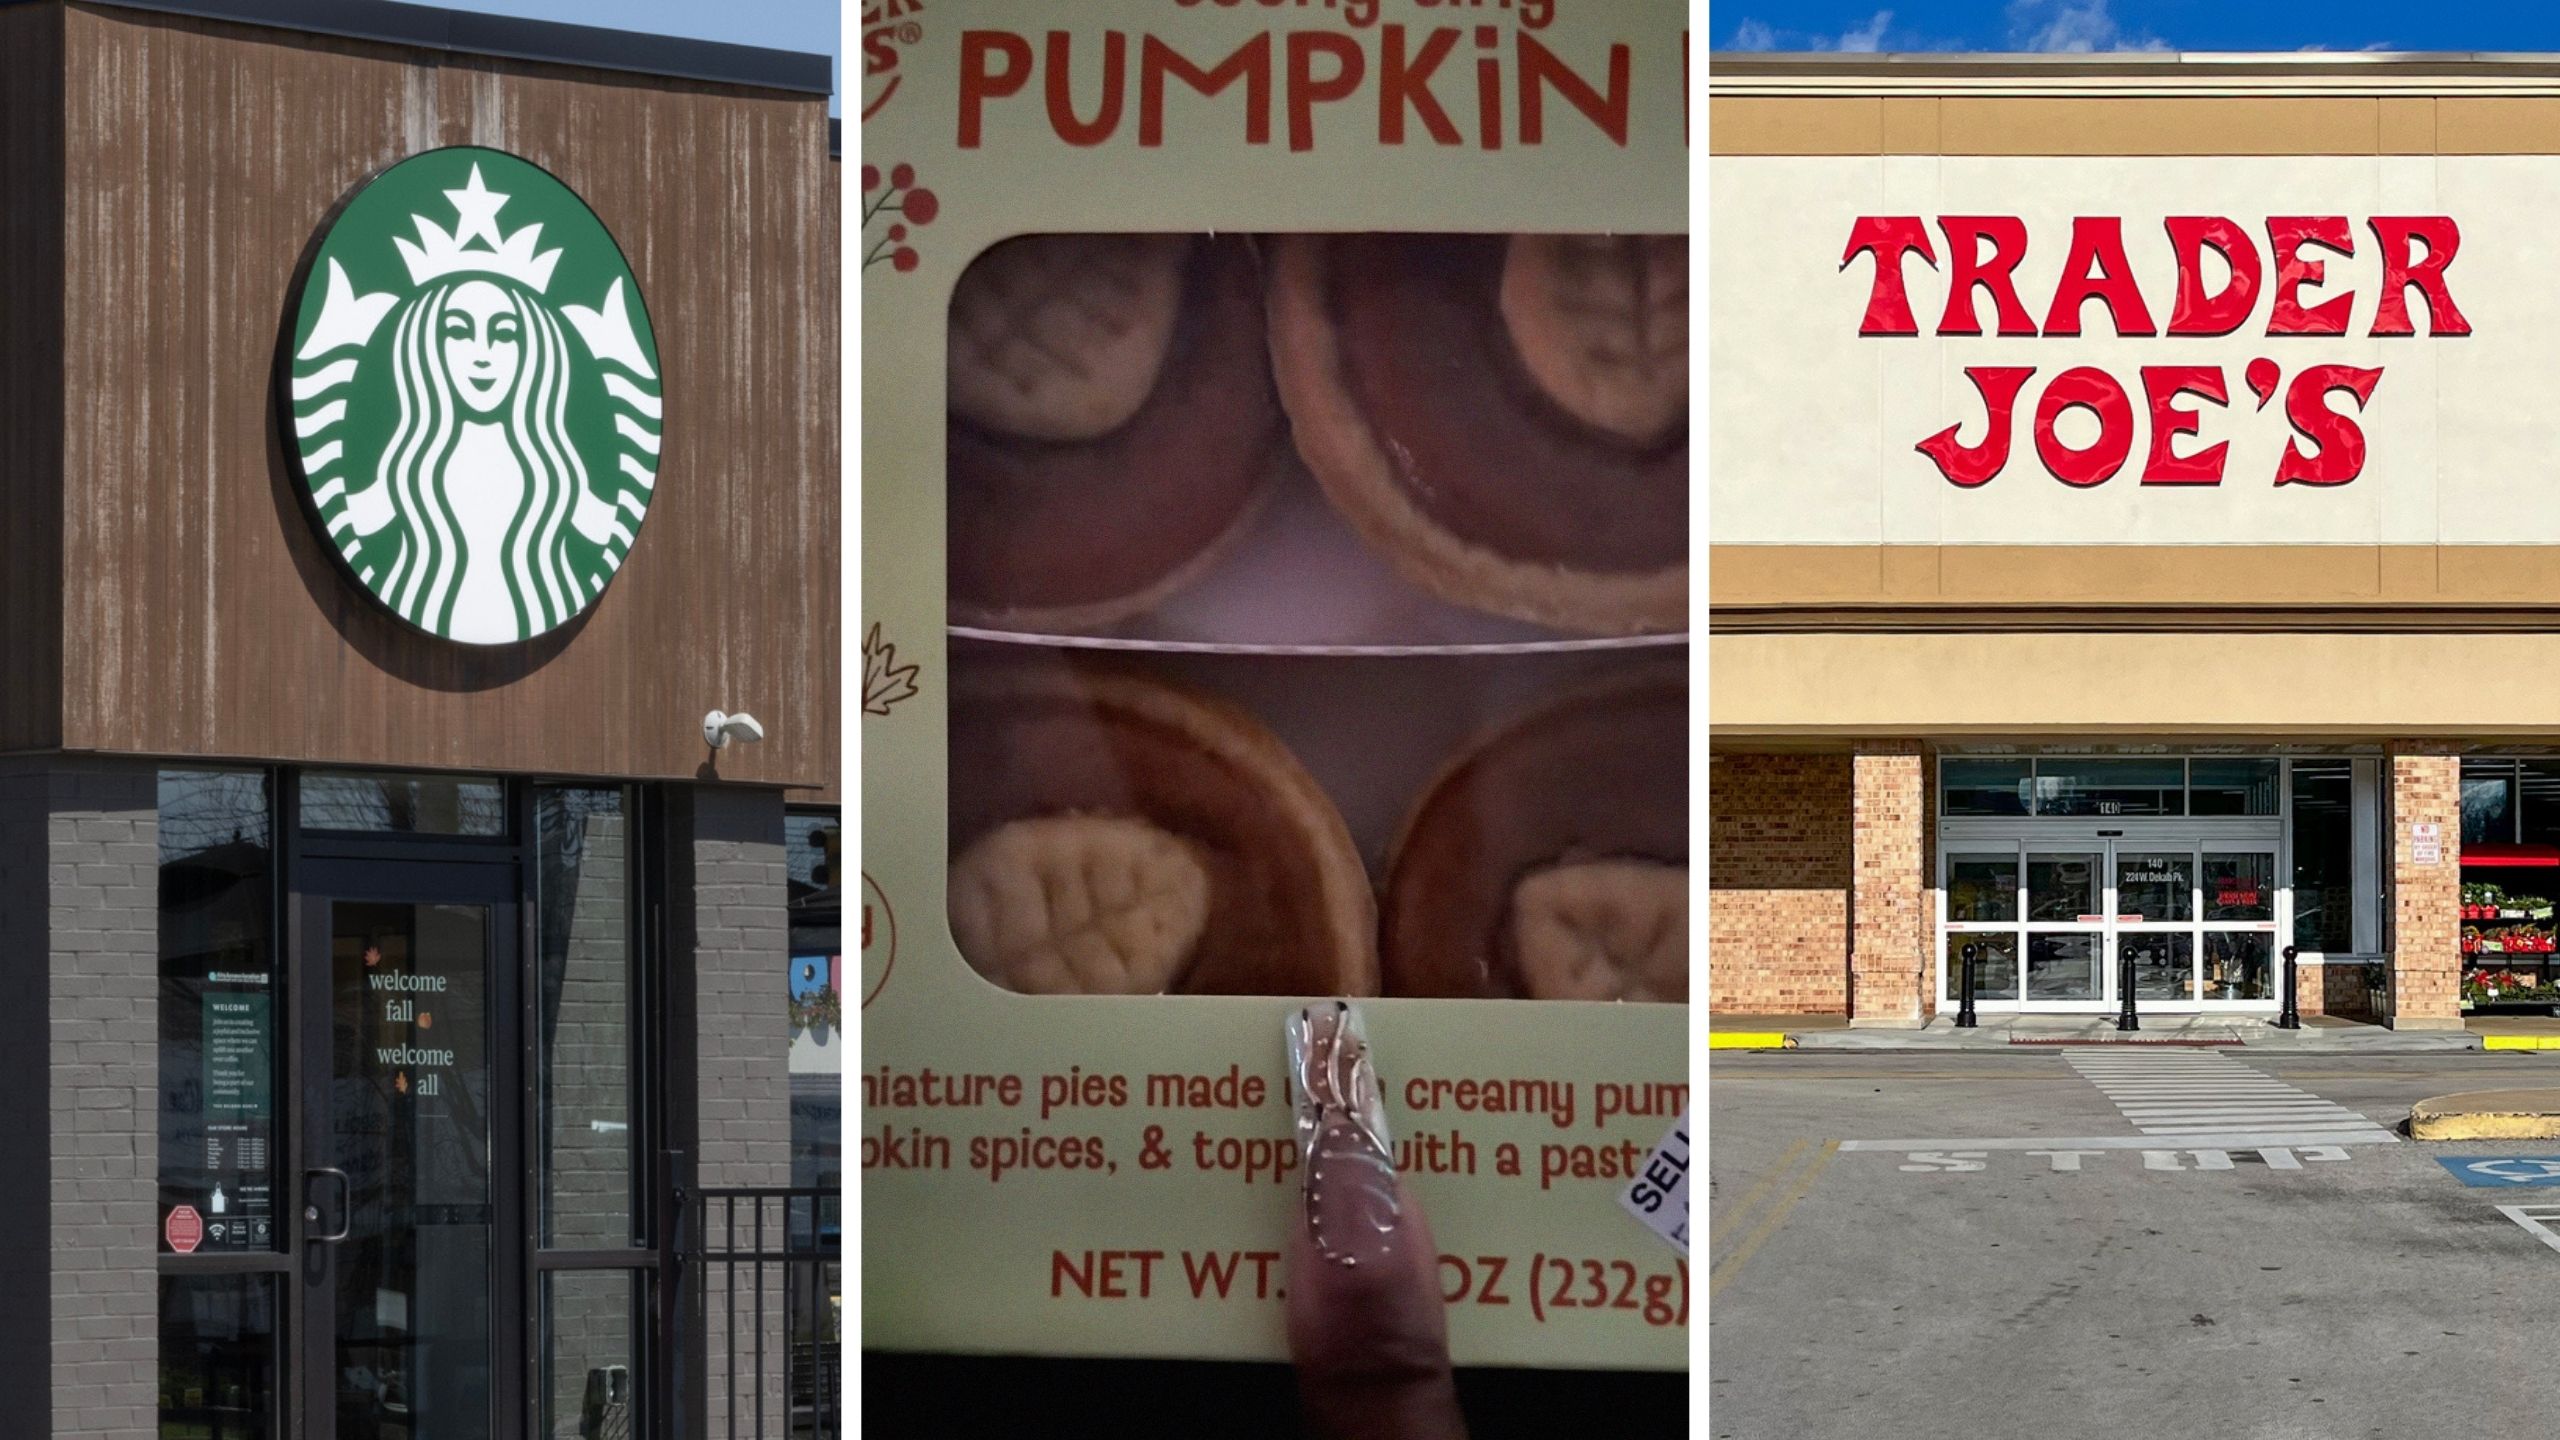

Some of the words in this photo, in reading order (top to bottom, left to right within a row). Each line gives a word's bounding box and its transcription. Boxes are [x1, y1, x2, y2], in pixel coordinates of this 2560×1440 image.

[1838, 215, 2473, 338] TRADER
[1914, 357, 2386, 488] JOE'S
[2100, 801, 2120, 814] 140
[2148, 858, 2163, 869] 140
[2149, 871, 2172, 882] Dekalb
[368, 969, 447, 992] welcome
[212, 1003, 250, 1012] WELCOME
[385, 1000, 414, 1022] fall
[377, 1042, 454, 1066] welcome
[417, 1073, 439, 1096] all
[1041, 1065, 1128, 1119] pies
[1147, 1064, 1266, 1109] made
[1405, 1077, 1574, 1128] creamy
[969, 1127, 1118, 1183] spices,
[1138, 1124, 1172, 1170] &
[1193, 1130, 1299, 1184] topp
[1495, 1141, 1521, 1176] a
[1051, 1249, 1164, 1299] NET
[1180, 1250, 1286, 1300] WT.
[1529, 1252, 1690, 1327] (232g)
